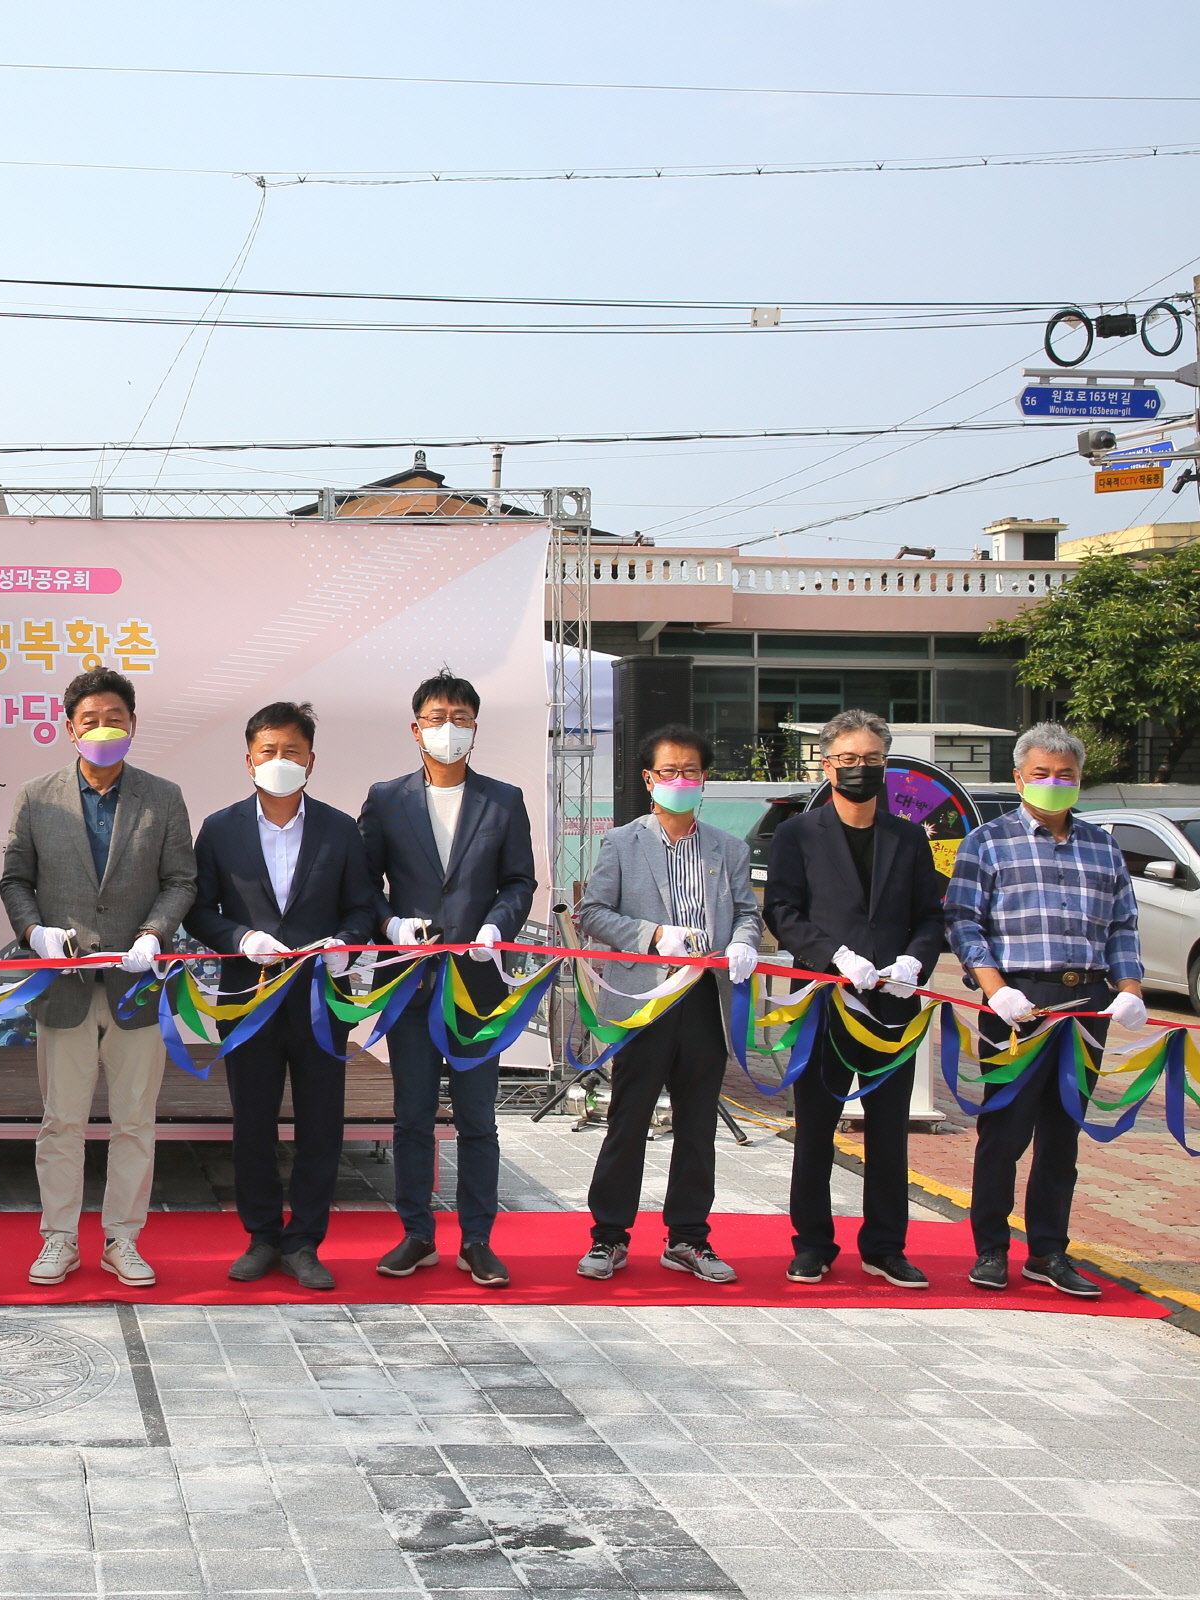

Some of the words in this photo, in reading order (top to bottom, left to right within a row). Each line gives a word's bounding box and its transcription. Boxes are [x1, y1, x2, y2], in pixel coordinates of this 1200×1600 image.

[1024, 396, 1037, 406] 36
[1144, 399, 1157, 409] 40
[1049, 405, 1087, 415] Wonhyo-ro
[1089, 406, 1131, 416] 163beon-gil
